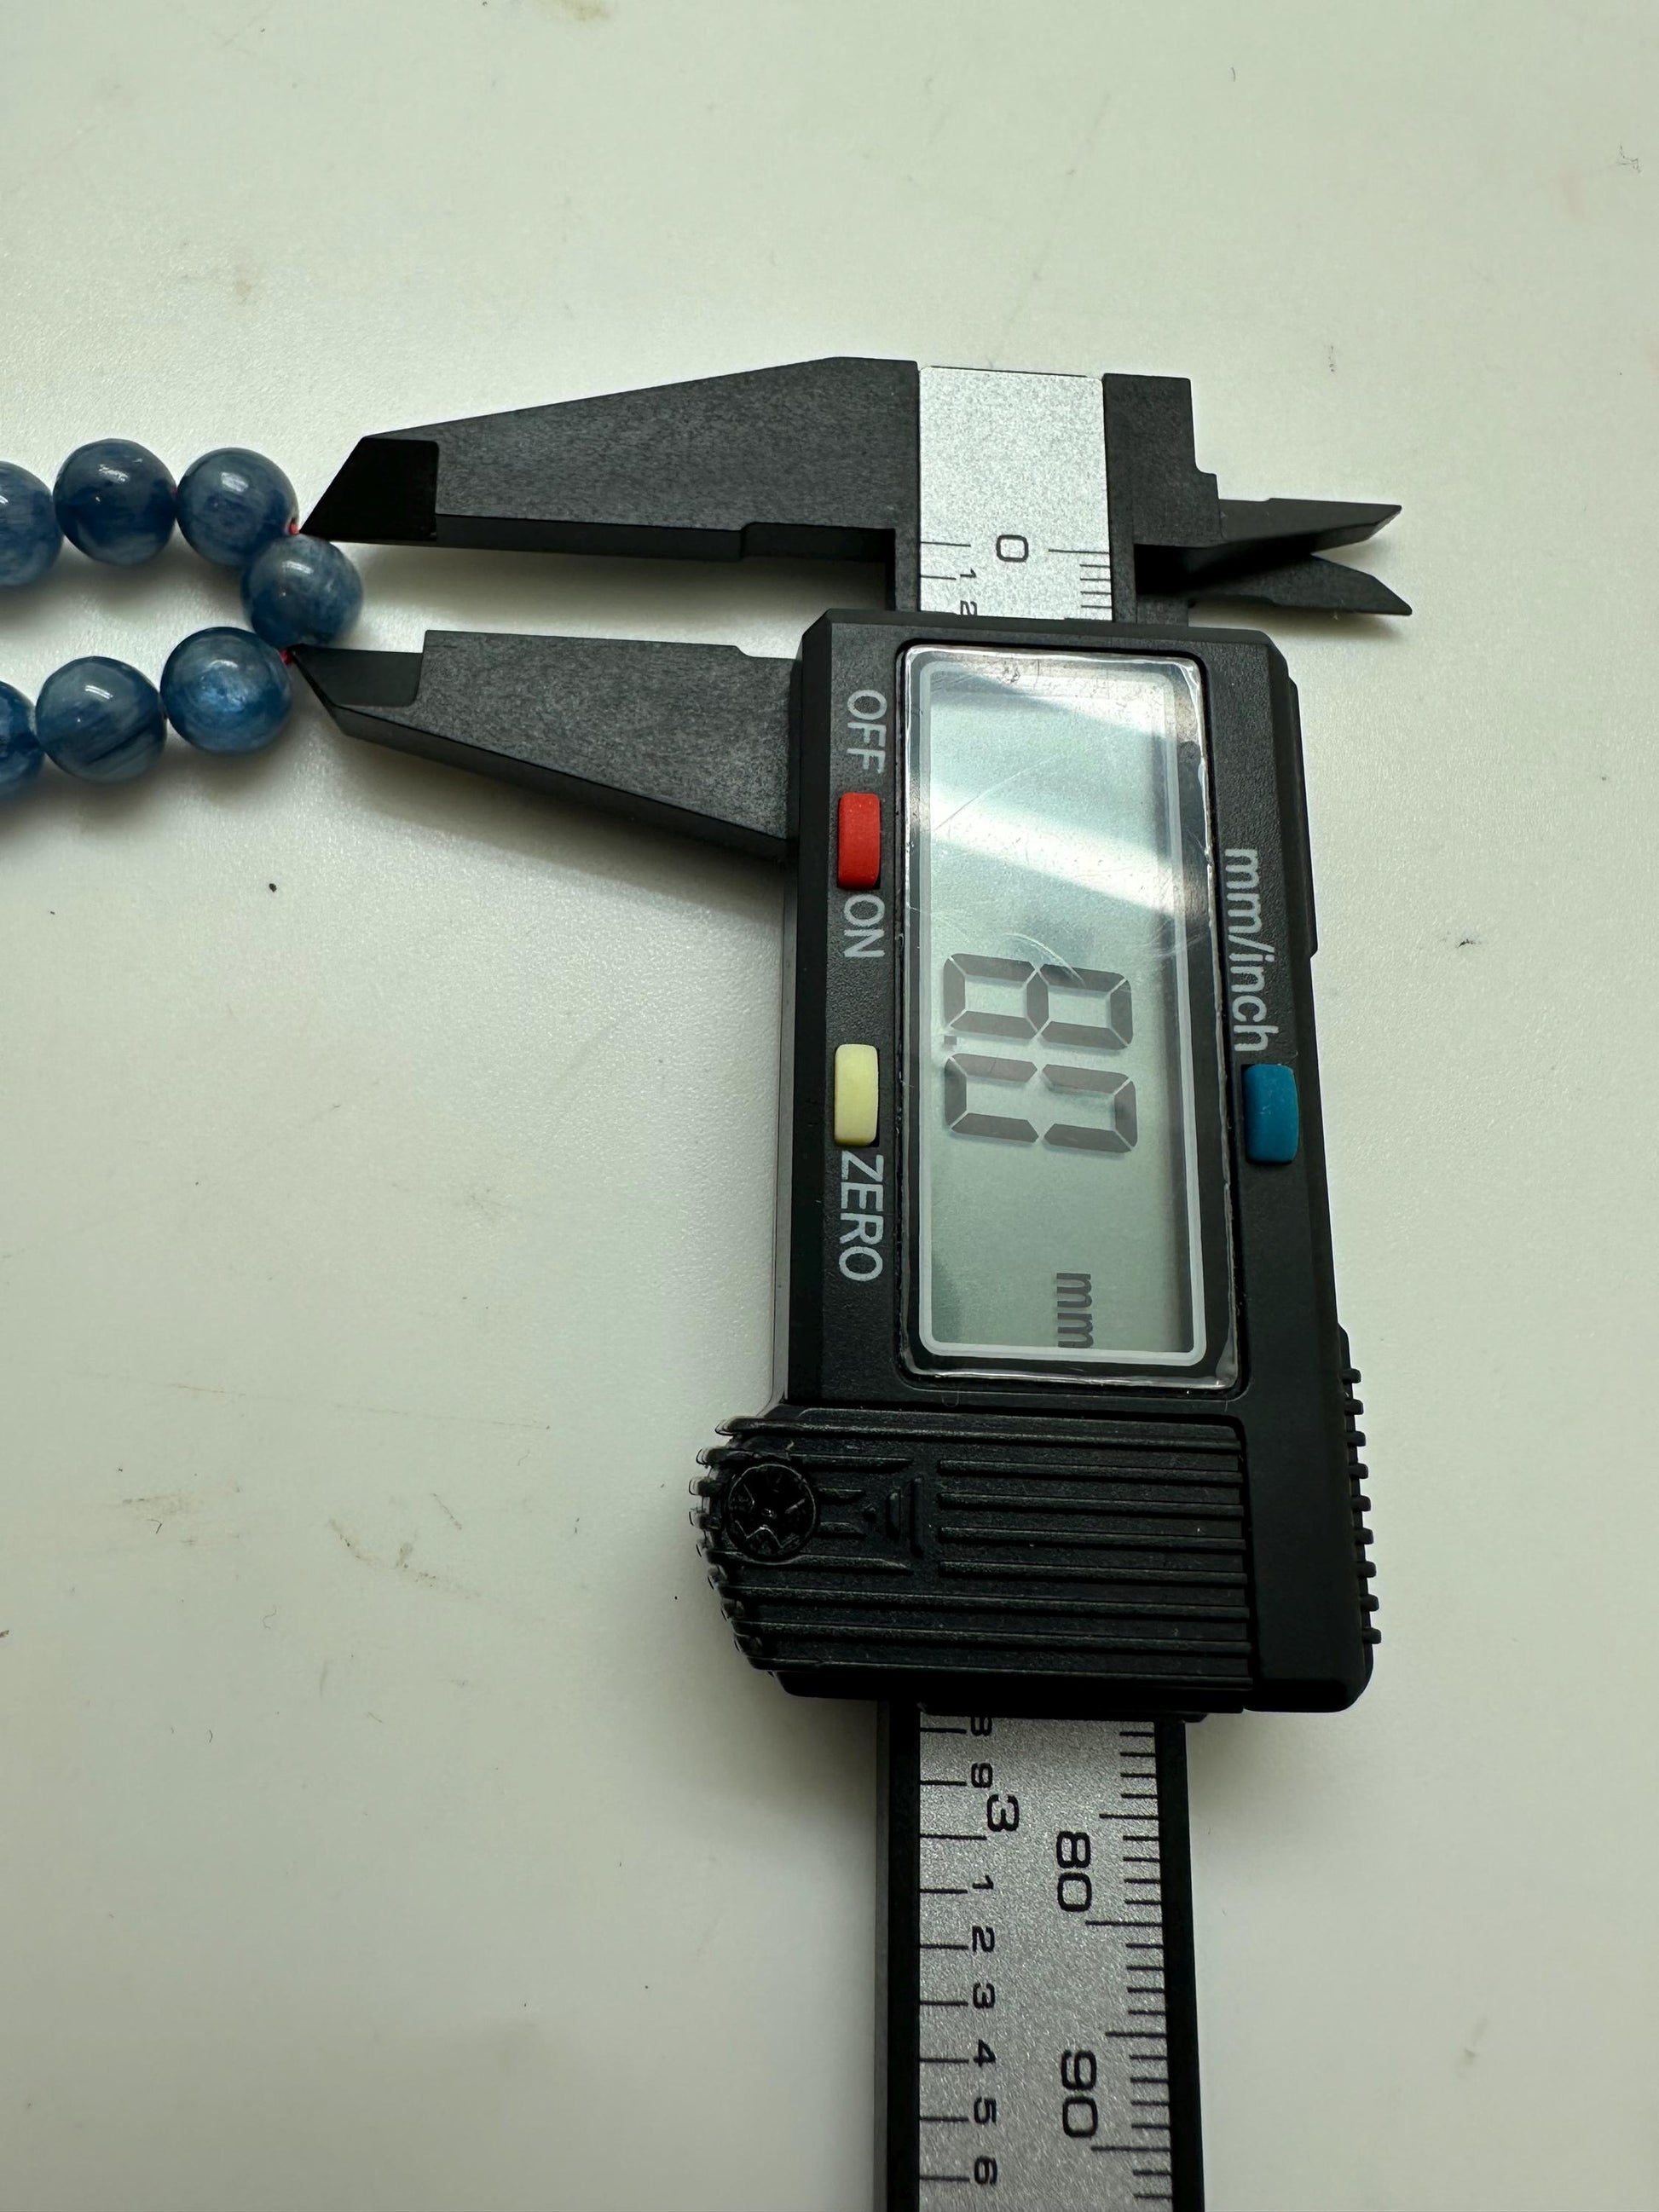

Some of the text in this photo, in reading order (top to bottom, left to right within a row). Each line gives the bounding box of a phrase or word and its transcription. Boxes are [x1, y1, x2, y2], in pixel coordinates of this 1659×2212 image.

[996, 534, 1029, 563] 0
[960, 568, 977, 578] 1
[960, 600, 978, 615] 2
[846, 689, 887, 774] OFF
[843, 893, 886, 959] ON
[1223, 848, 1280, 1053] mm/inch
[943, 952, 1138, 1154] 8.0
[838, 1150, 884, 1282] ZERO
[1056, 1272, 1095, 1349] mm
[970, 1762, 993, 1788] 9
[987, 1793, 1020, 1832] 3
[973, 1874, 994, 1889] 1
[1056, 1831, 1092, 1913] 80
[972, 1926, 995, 1952] 2
[973, 1982, 996, 2009] 3
[974, 2039, 997, 2067] 4
[1061, 2049, 1099, 2138] 90
[974, 2097, 997, 2124] 5
[974, 2156, 997, 2186] 6
